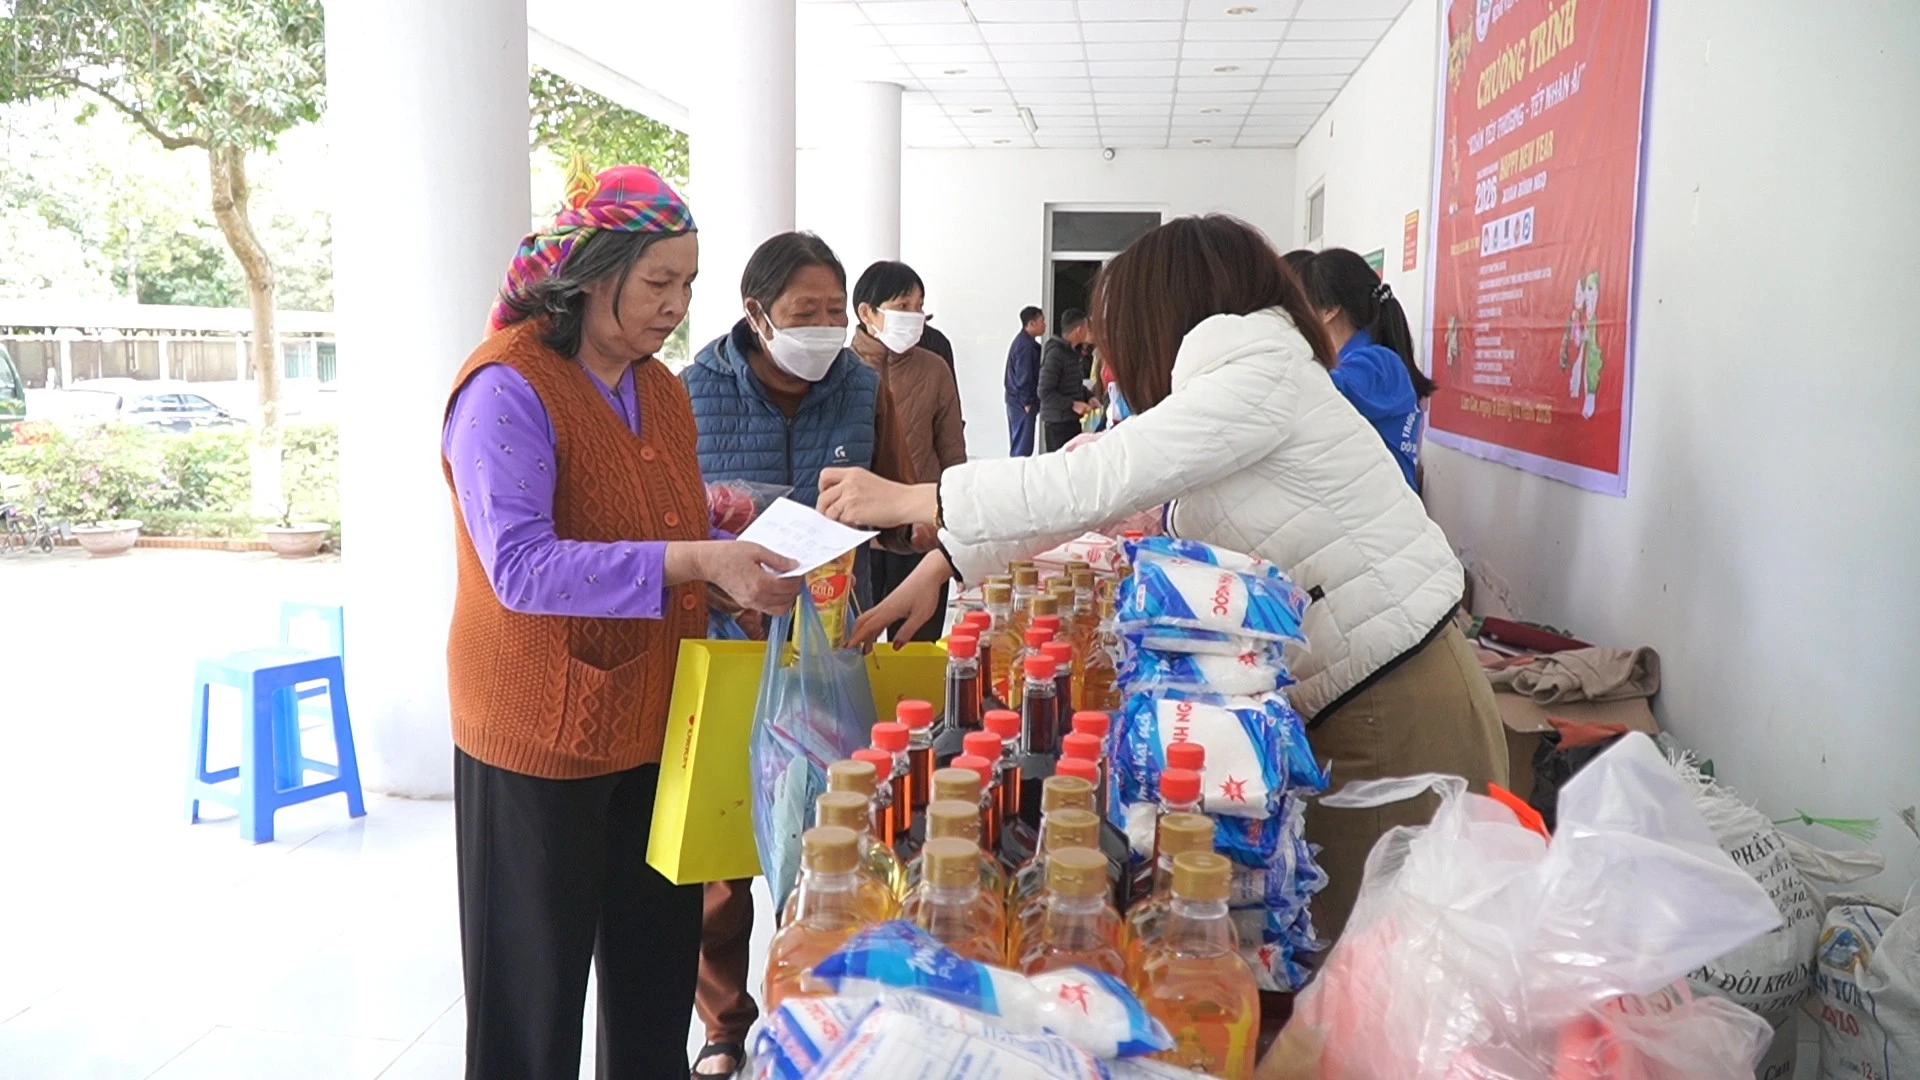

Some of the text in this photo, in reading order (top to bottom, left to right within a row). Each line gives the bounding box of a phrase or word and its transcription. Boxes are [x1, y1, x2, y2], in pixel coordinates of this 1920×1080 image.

[1477, 0, 1577, 110] CHƯƠNG TRÌNH
[1475, 174, 1498, 216] 2026
[810, 583, 835, 598] GOLD
[1718, 969, 1762, 995] ĐÔI
